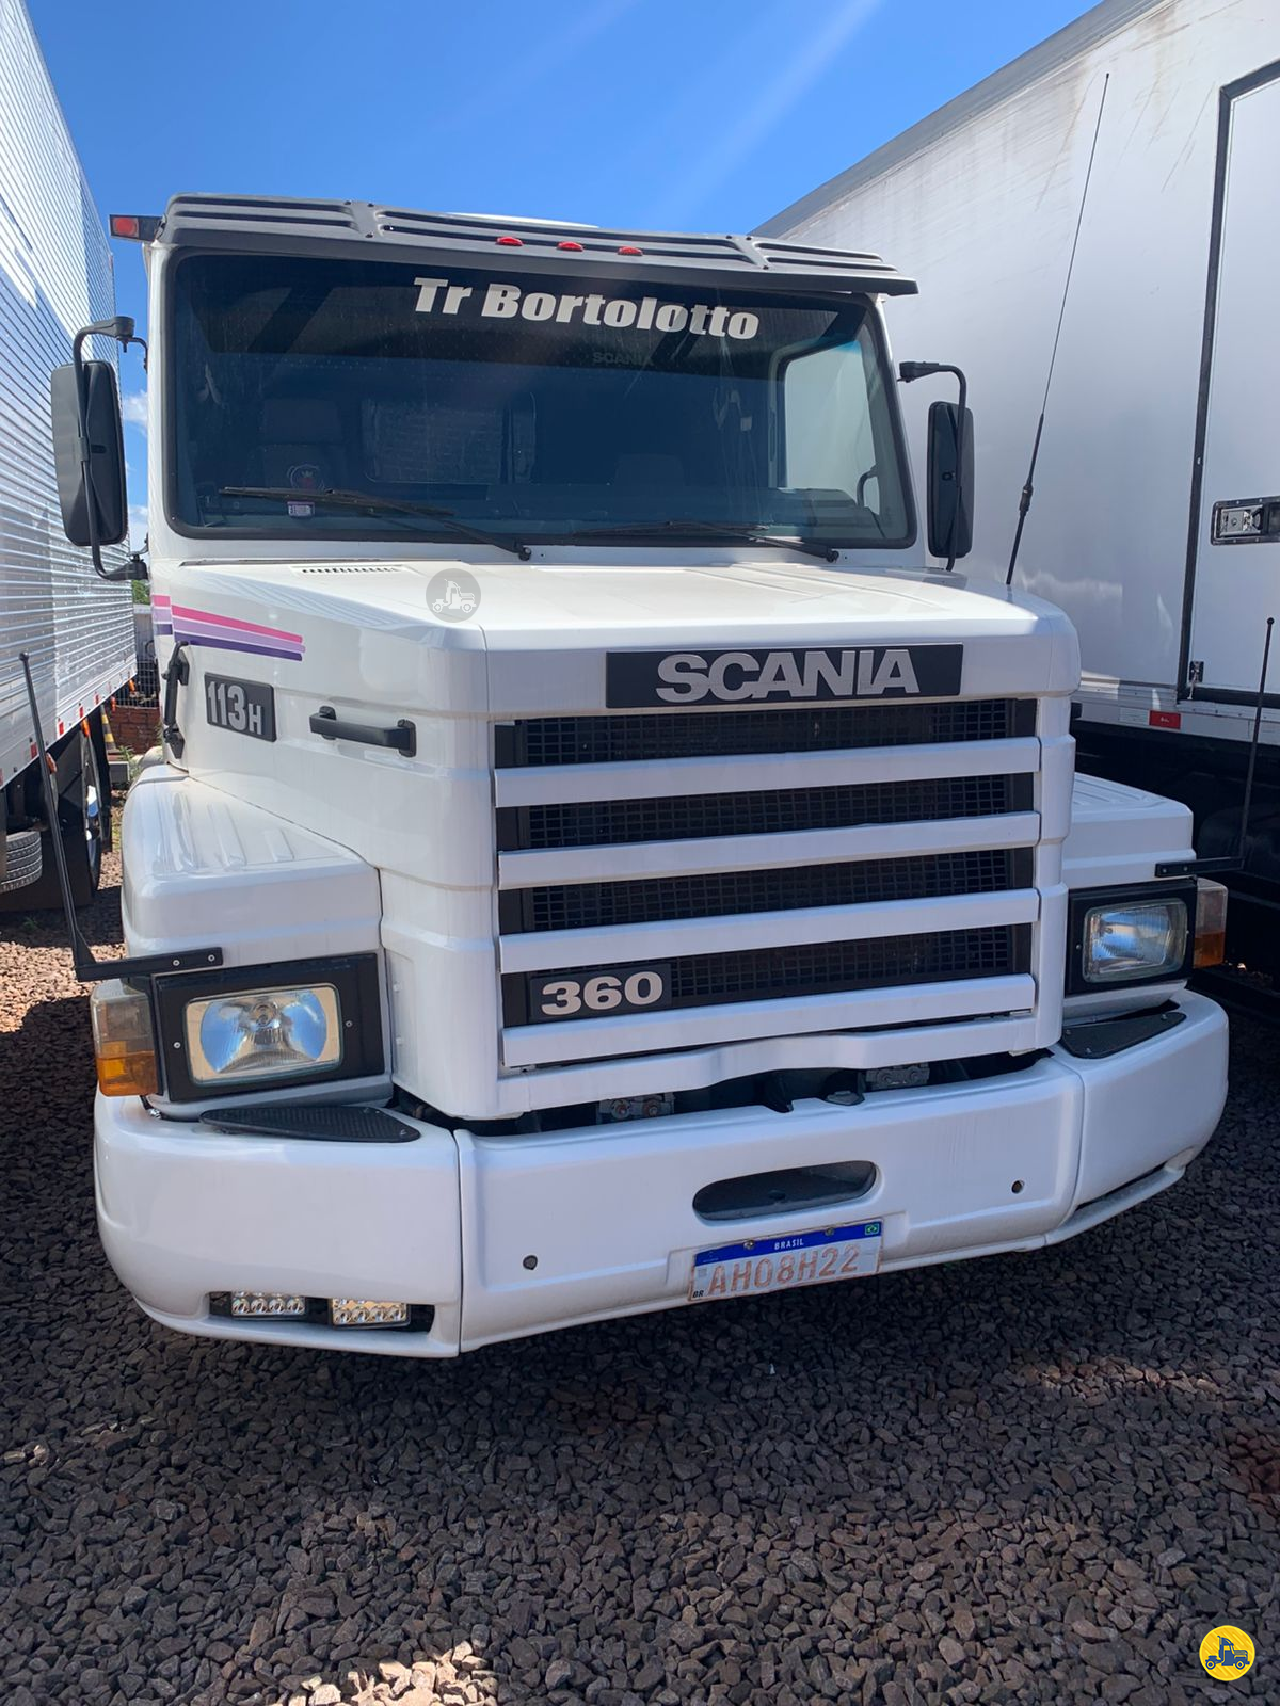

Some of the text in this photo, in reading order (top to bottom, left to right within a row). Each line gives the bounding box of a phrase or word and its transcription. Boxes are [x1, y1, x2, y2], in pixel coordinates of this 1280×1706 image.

[413, 277, 760, 340] Tr Bortolotto
[656, 648, 921, 703] SCANIA
[541, 971, 663, 1016] 360
[774, 1239, 804, 1250] BRASIL
